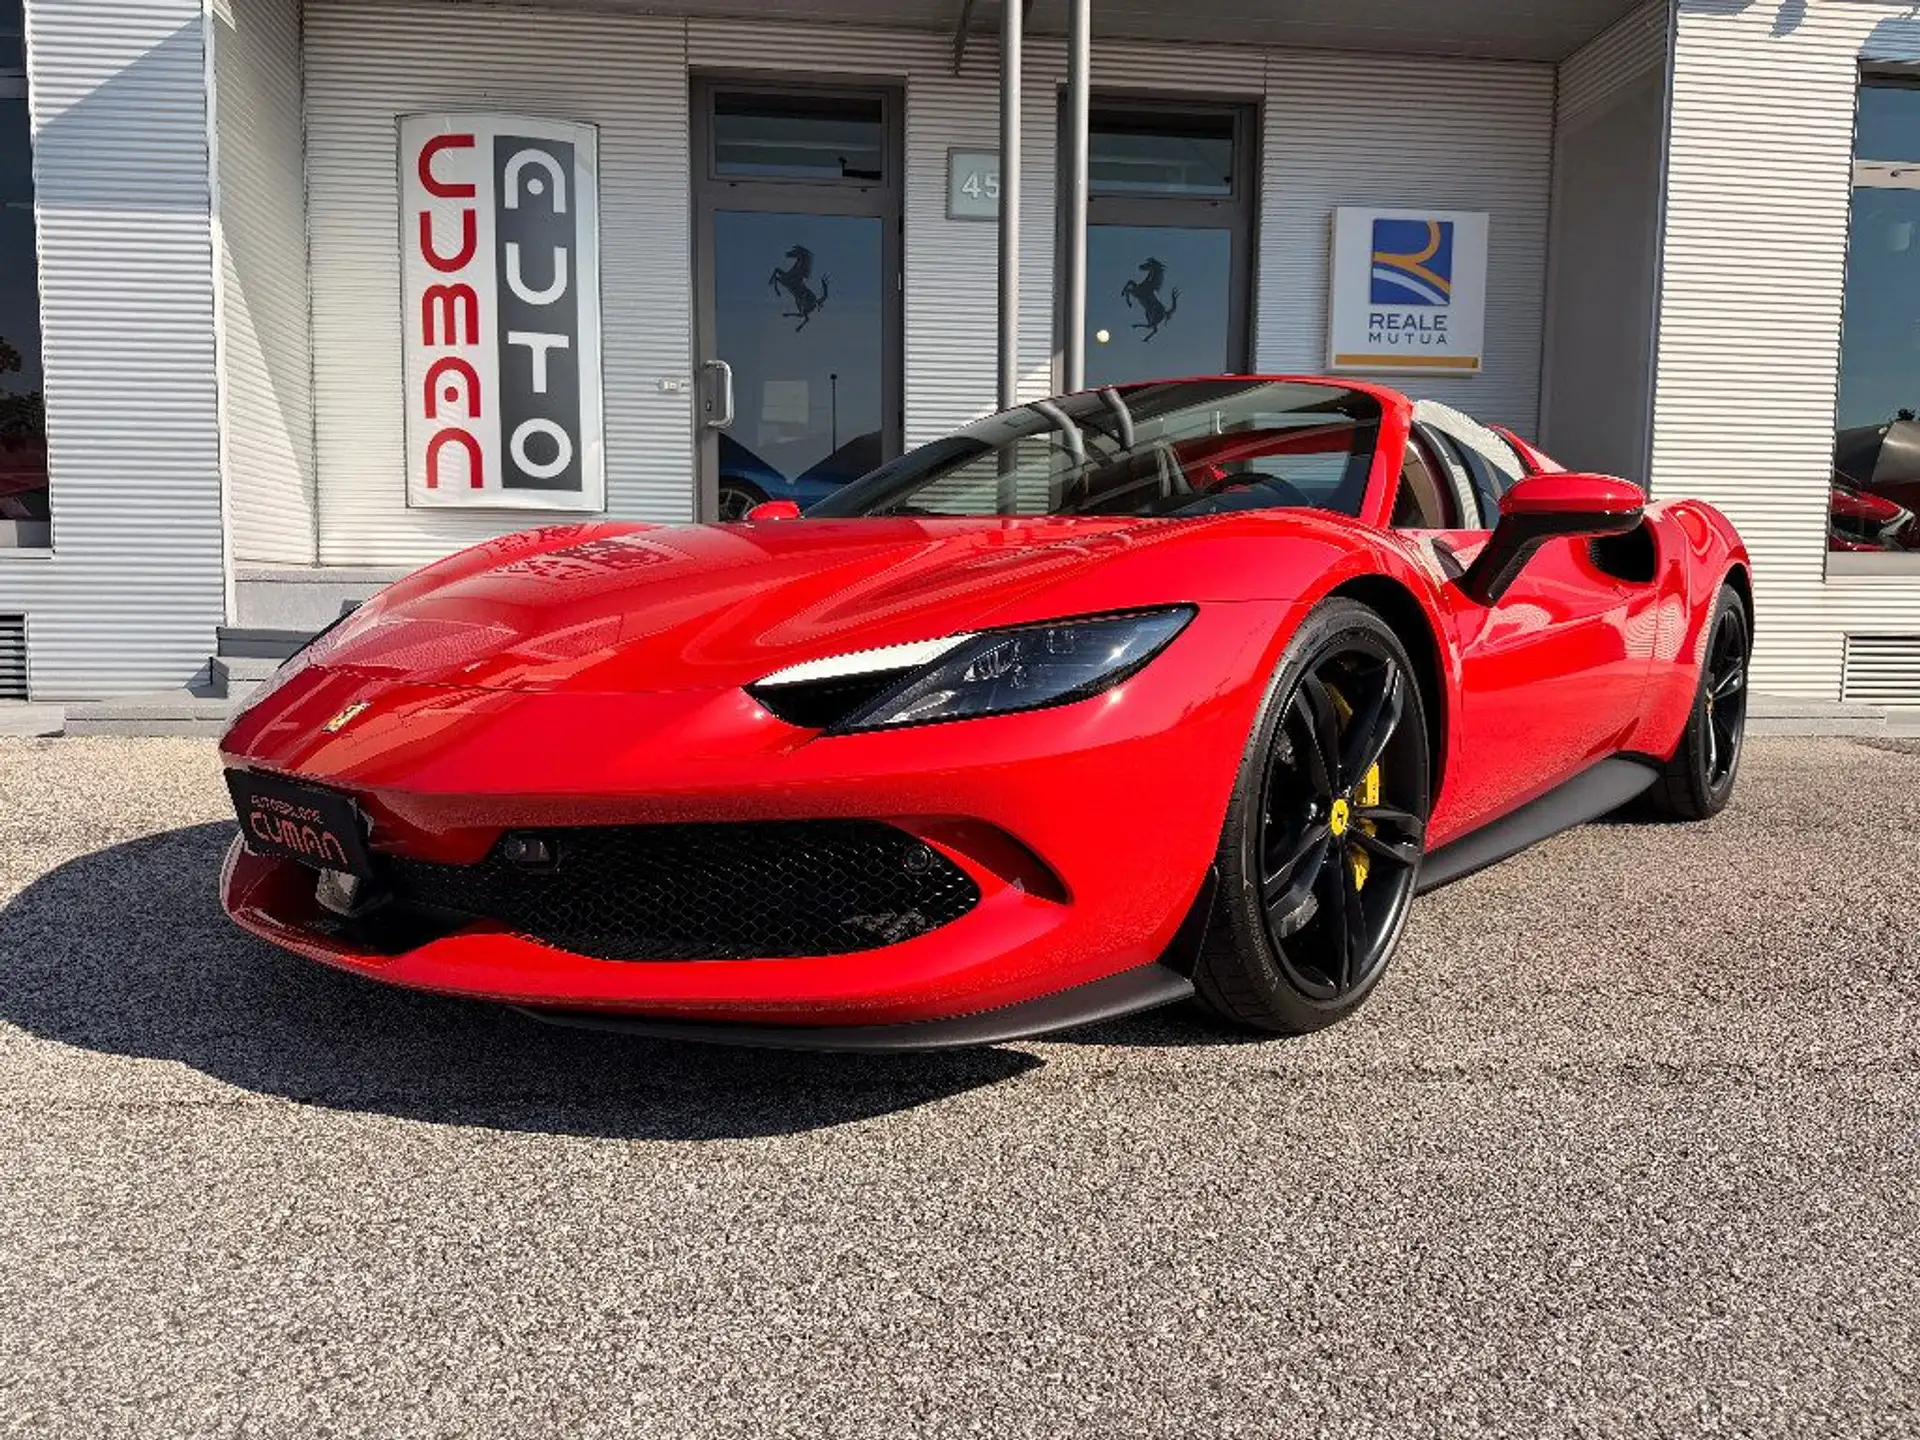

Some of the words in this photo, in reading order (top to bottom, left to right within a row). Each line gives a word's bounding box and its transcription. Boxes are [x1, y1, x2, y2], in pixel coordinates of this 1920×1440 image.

[418, 134, 484, 489] CUMAN
[503, 148, 573, 479] AUTO
[1368, 313, 1448, 332] REALE
[1368, 332, 1448, 345] MUTUA
[250, 812, 348, 867] CUMAN
